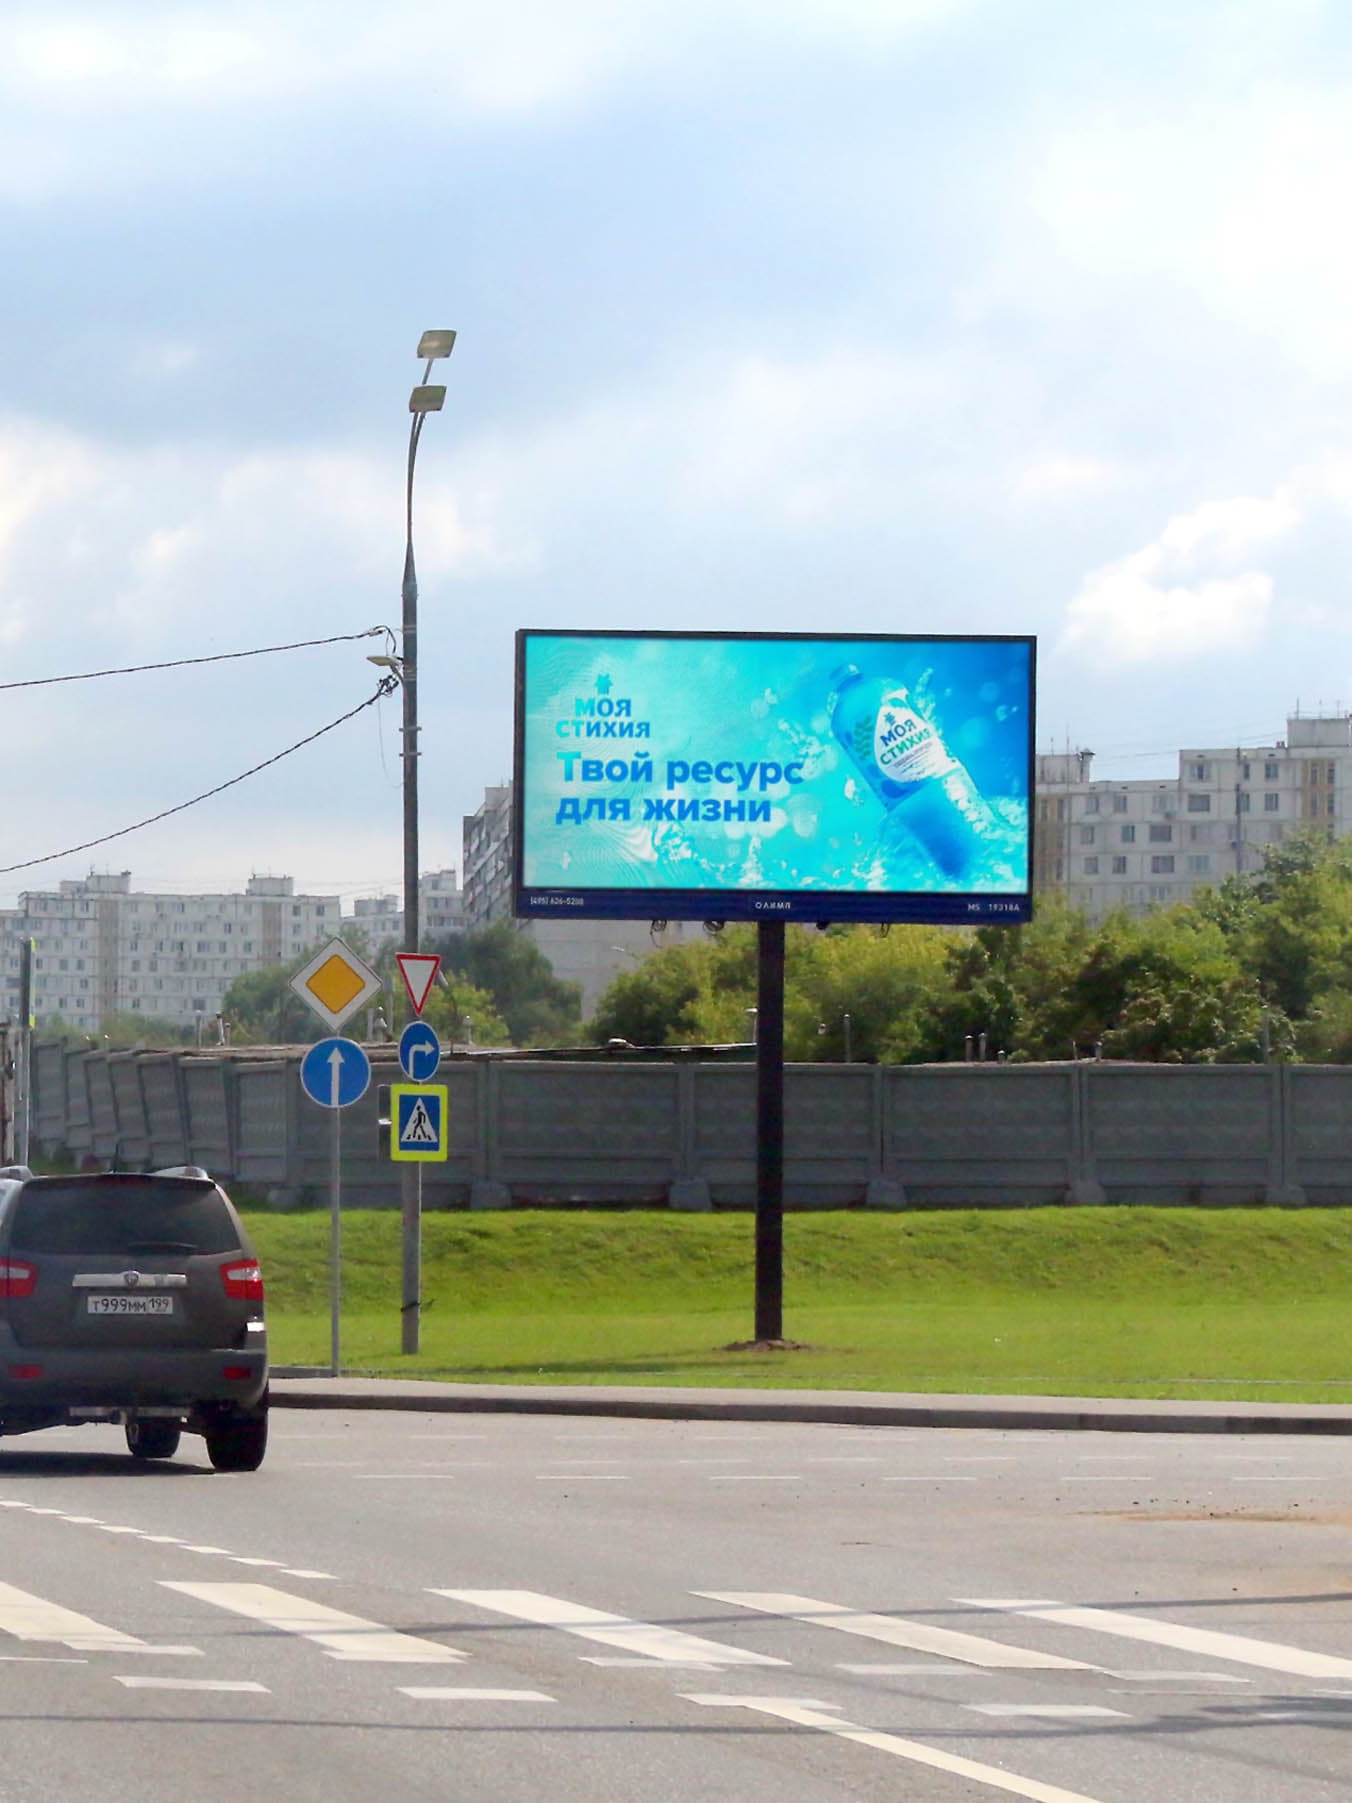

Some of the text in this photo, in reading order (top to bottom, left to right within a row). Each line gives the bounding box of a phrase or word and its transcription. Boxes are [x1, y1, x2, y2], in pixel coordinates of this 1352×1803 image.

[575, 697, 632, 718] МОЯ
[555, 720, 651, 739] СТИХИЯ
[879, 718, 917, 747] МОЯ
[556, 751, 805, 792] Твой ресурс
[555, 797, 771, 825] для жизни
[91, 1297, 147, 1313] Т999ММ
